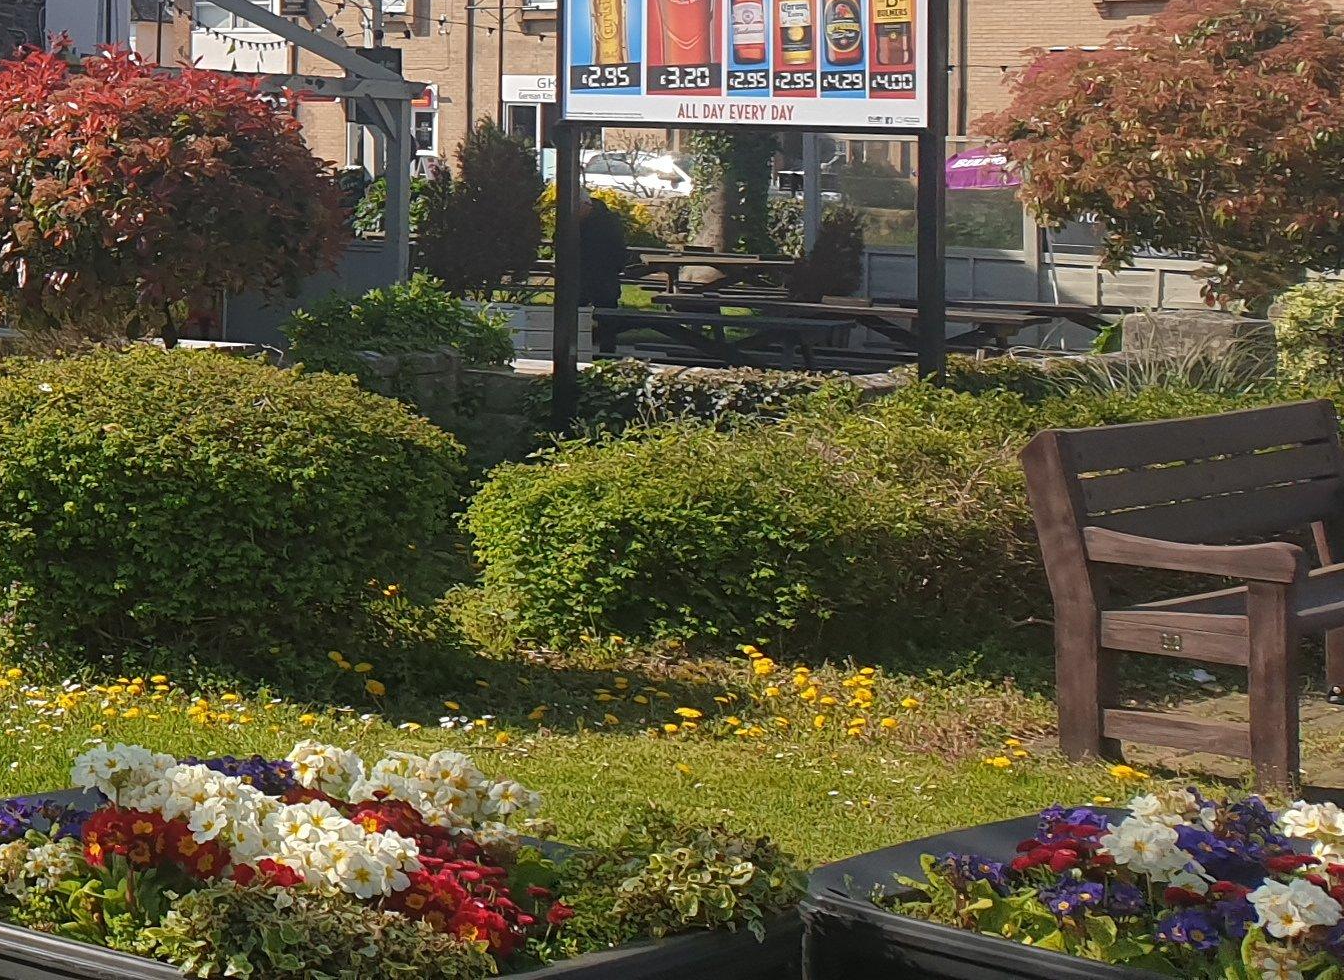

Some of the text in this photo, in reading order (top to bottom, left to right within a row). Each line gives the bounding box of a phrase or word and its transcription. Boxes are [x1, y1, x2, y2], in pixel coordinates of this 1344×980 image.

[582, 67, 630, 88] £2.95
[660, 67, 710, 88] £3.20
[730, 72, 767, 89] £2.95
[776, 72, 814, 89] £2.95
[823, 73, 863, 89] £4.29
[872, 73, 913, 90] £4.00
[677, 103, 795, 120] ALL DAY EVERY DAY
